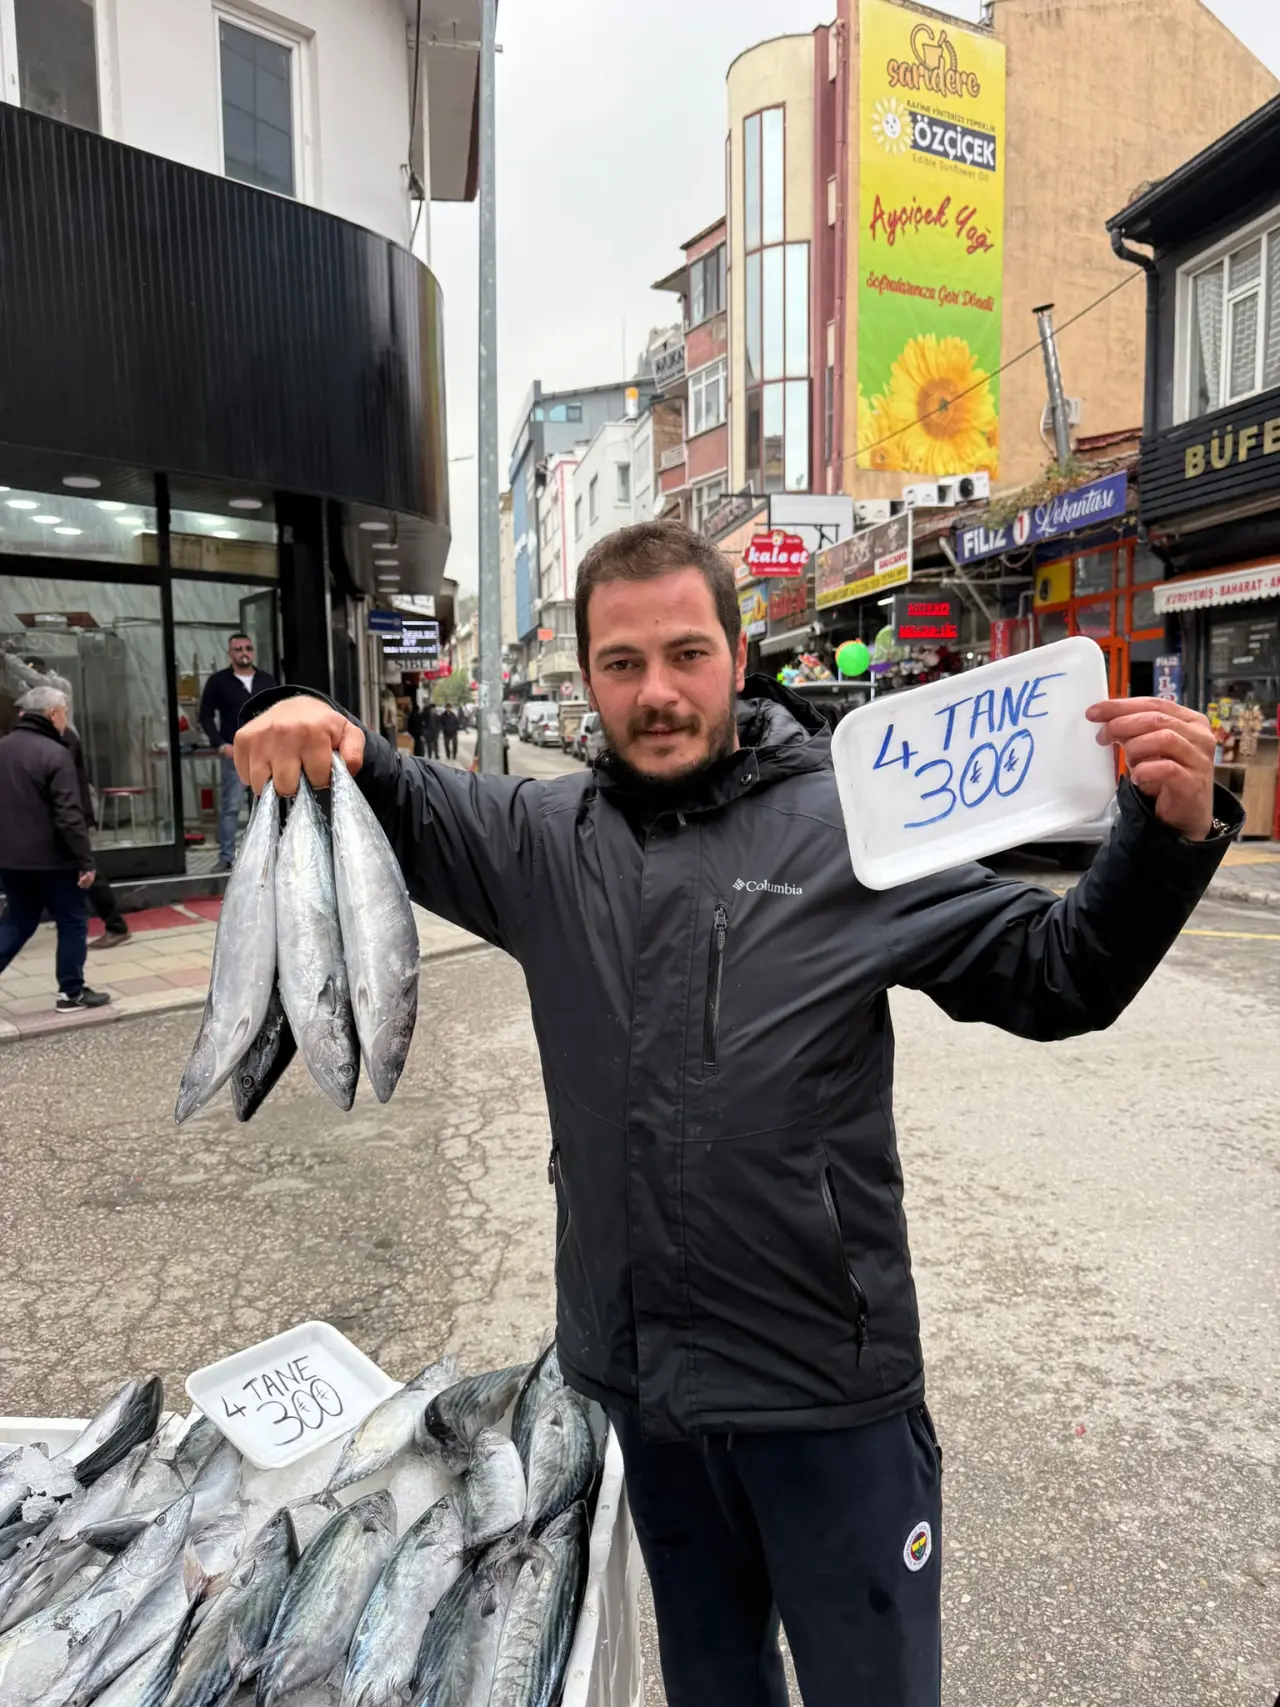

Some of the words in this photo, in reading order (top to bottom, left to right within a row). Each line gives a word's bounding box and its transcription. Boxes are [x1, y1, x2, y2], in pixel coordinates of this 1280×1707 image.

[914, 114, 995, 167] ÖZÇİÇEK
[869, 194, 952, 247] Ayçiçek
[1184, 417, 1280, 480] BÜFE
[1220, 578, 1263, 597] BAHARAT
[873, 724, 919, 770] 4
[935, 672, 1067, 751] TANE
[745, 879, 803, 895] Columbia
[221, 1396, 247, 1417] 4
[242, 1355, 317, 1401] TANE
